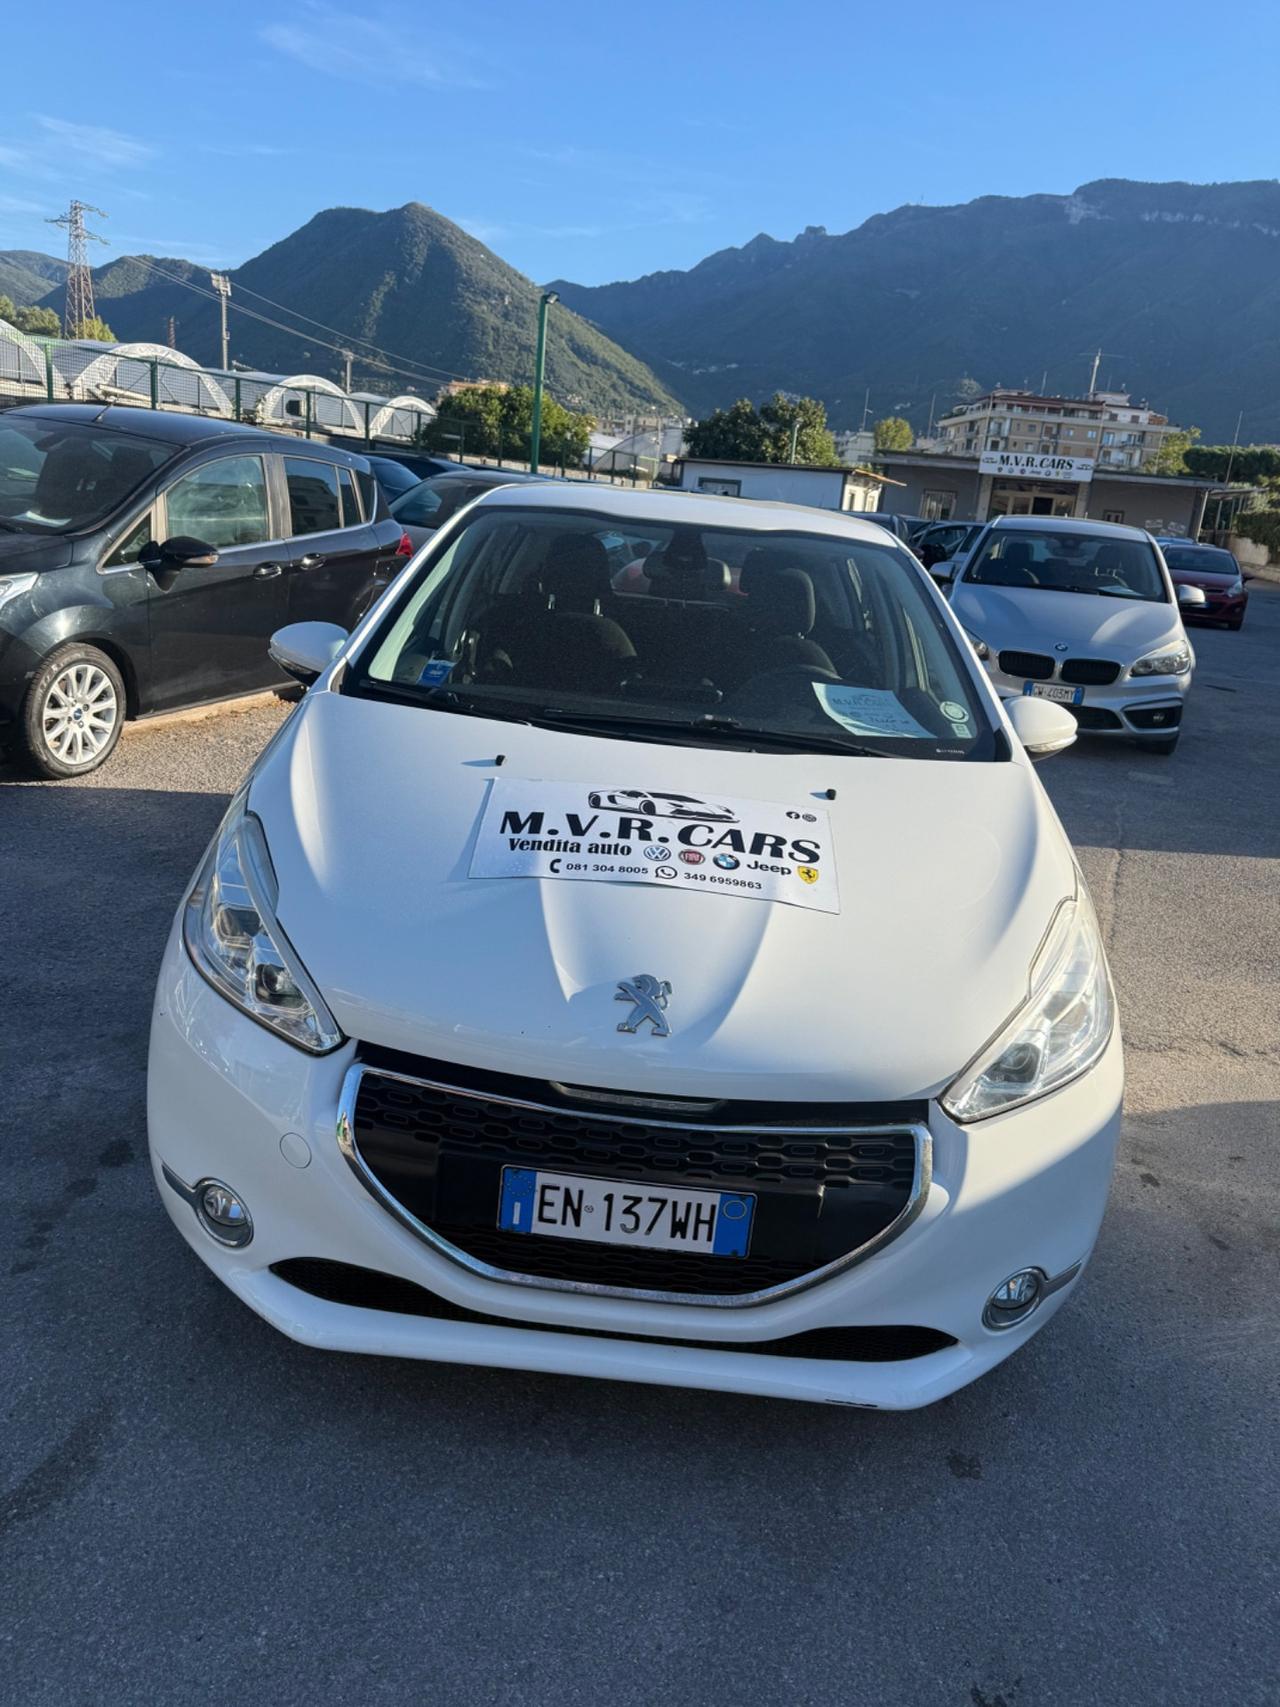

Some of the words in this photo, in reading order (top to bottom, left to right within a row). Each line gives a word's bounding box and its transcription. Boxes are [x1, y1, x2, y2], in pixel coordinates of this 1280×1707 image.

[508, 838, 581, 854] Vendita
[587, 842, 632, 857] auto
[747, 859, 792, 876] Jeep
[565, 862, 589, 872] 081
[592, 864, 614, 874] 304
[618, 865, 649, 875] 8005
[683, 872, 706, 883] 349
[709, 875, 763, 891] 6959863
[537, 1184, 584, 1227] EN
[603, 1193, 716, 1242] 137WH
